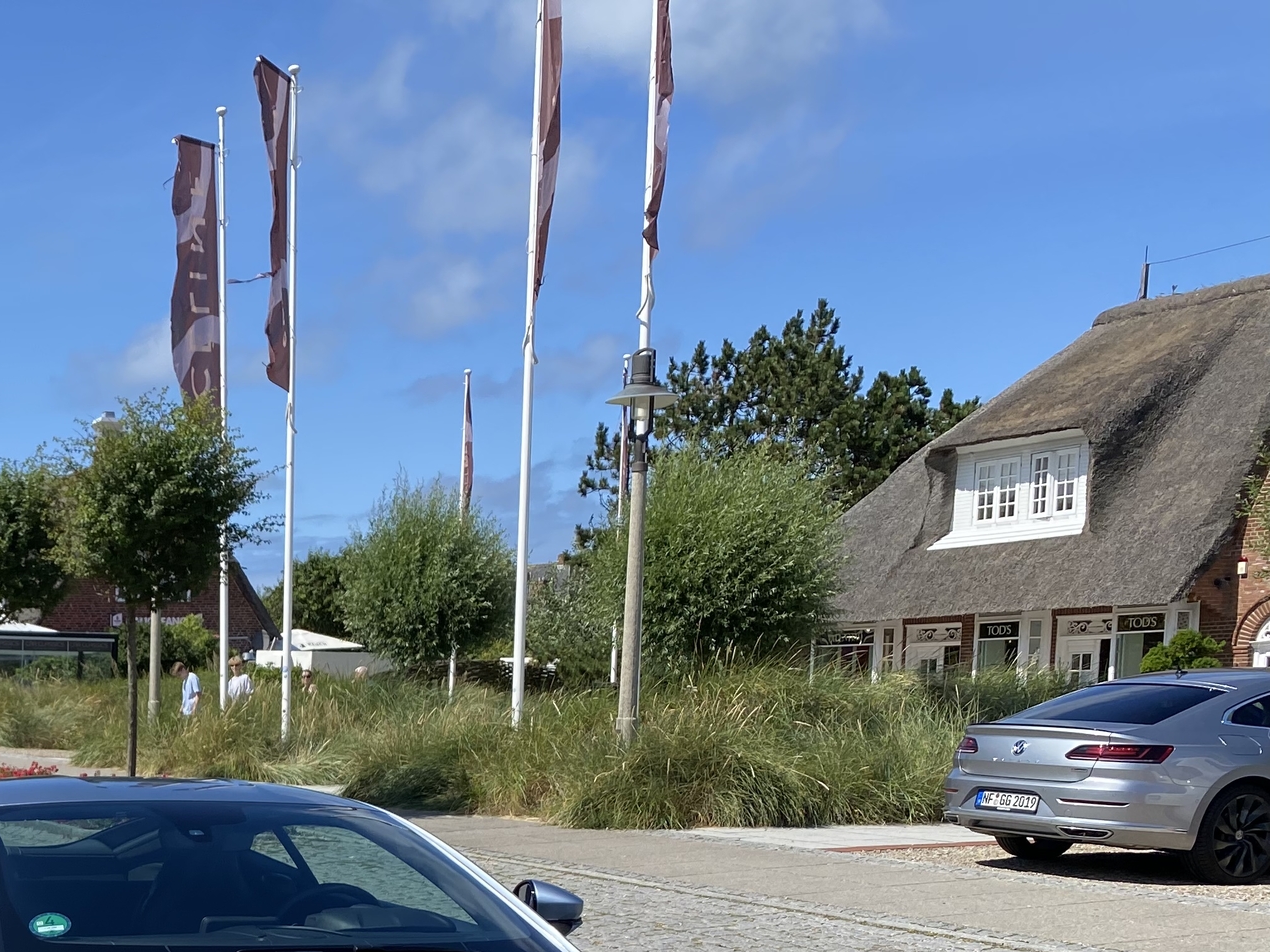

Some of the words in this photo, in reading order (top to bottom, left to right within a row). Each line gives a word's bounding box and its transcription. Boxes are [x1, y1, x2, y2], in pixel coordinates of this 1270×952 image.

[1127, 617, 1158, 629] TOD'S
[987, 624, 1012, 636] TOD'S
[982, 791, 994, 805] NF
[999, 793, 1012, 806] GG
[1013, 795, 1037, 809] 2019
[45, 916, 55, 925] 4
